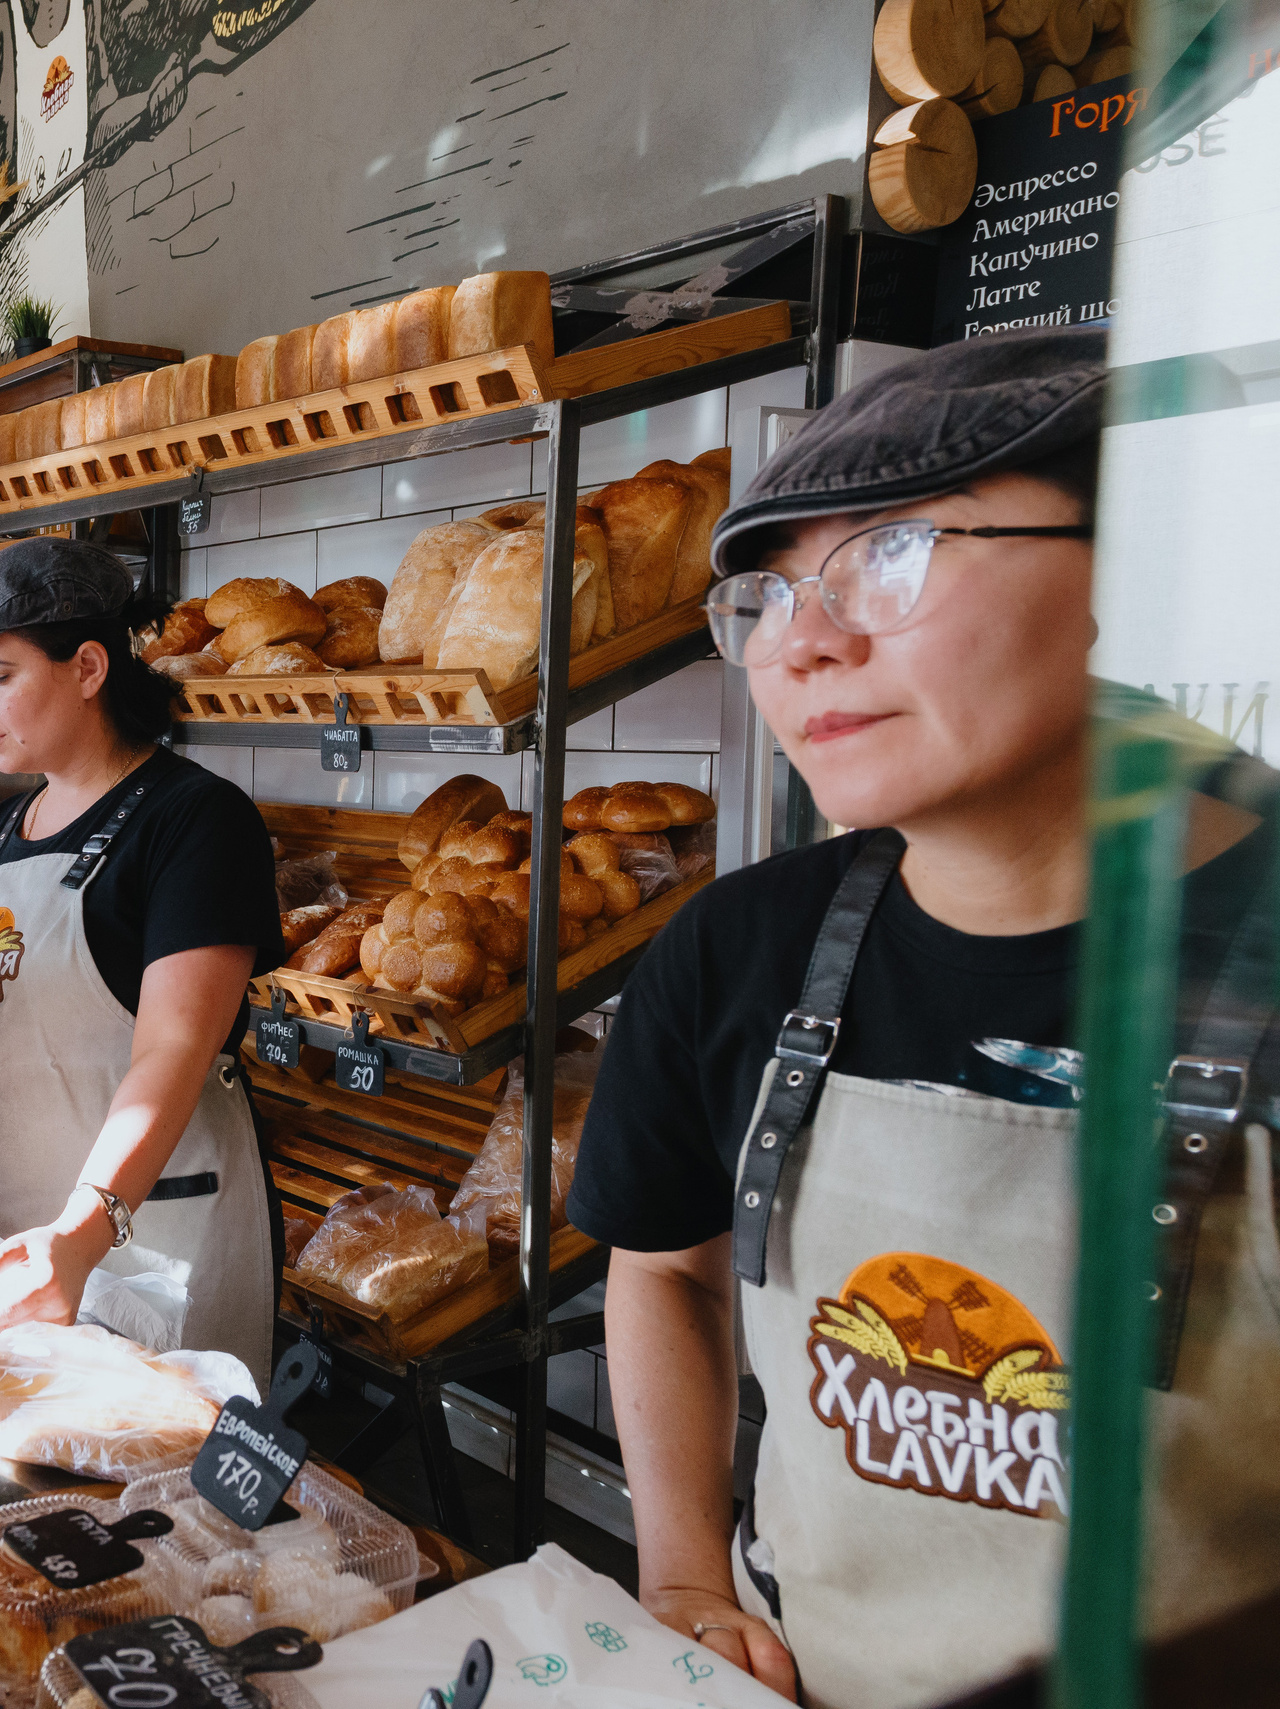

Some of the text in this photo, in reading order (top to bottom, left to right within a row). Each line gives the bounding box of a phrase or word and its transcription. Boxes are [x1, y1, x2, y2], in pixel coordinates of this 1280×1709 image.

[974, 161, 1098, 208] Эспрессо
[972, 191, 1120, 242] Американо
[969, 232, 1100, 277] Капучино
[966, 280, 1041, 311] Латте
[324, 730, 358, 742] ЧИАБАТТА
[261, 1020, 294, 1038] ФИТНЕС
[338, 1046, 379, 1066] РОМАШКА
[349, 1065, 375, 1092] 50
[815, 1343, 1065, 1472] Хлебна
[214, 1409, 300, 1478] ЕВРОПЕЙСКОЕ
[856, 1417, 1070, 1517] LAVKA
